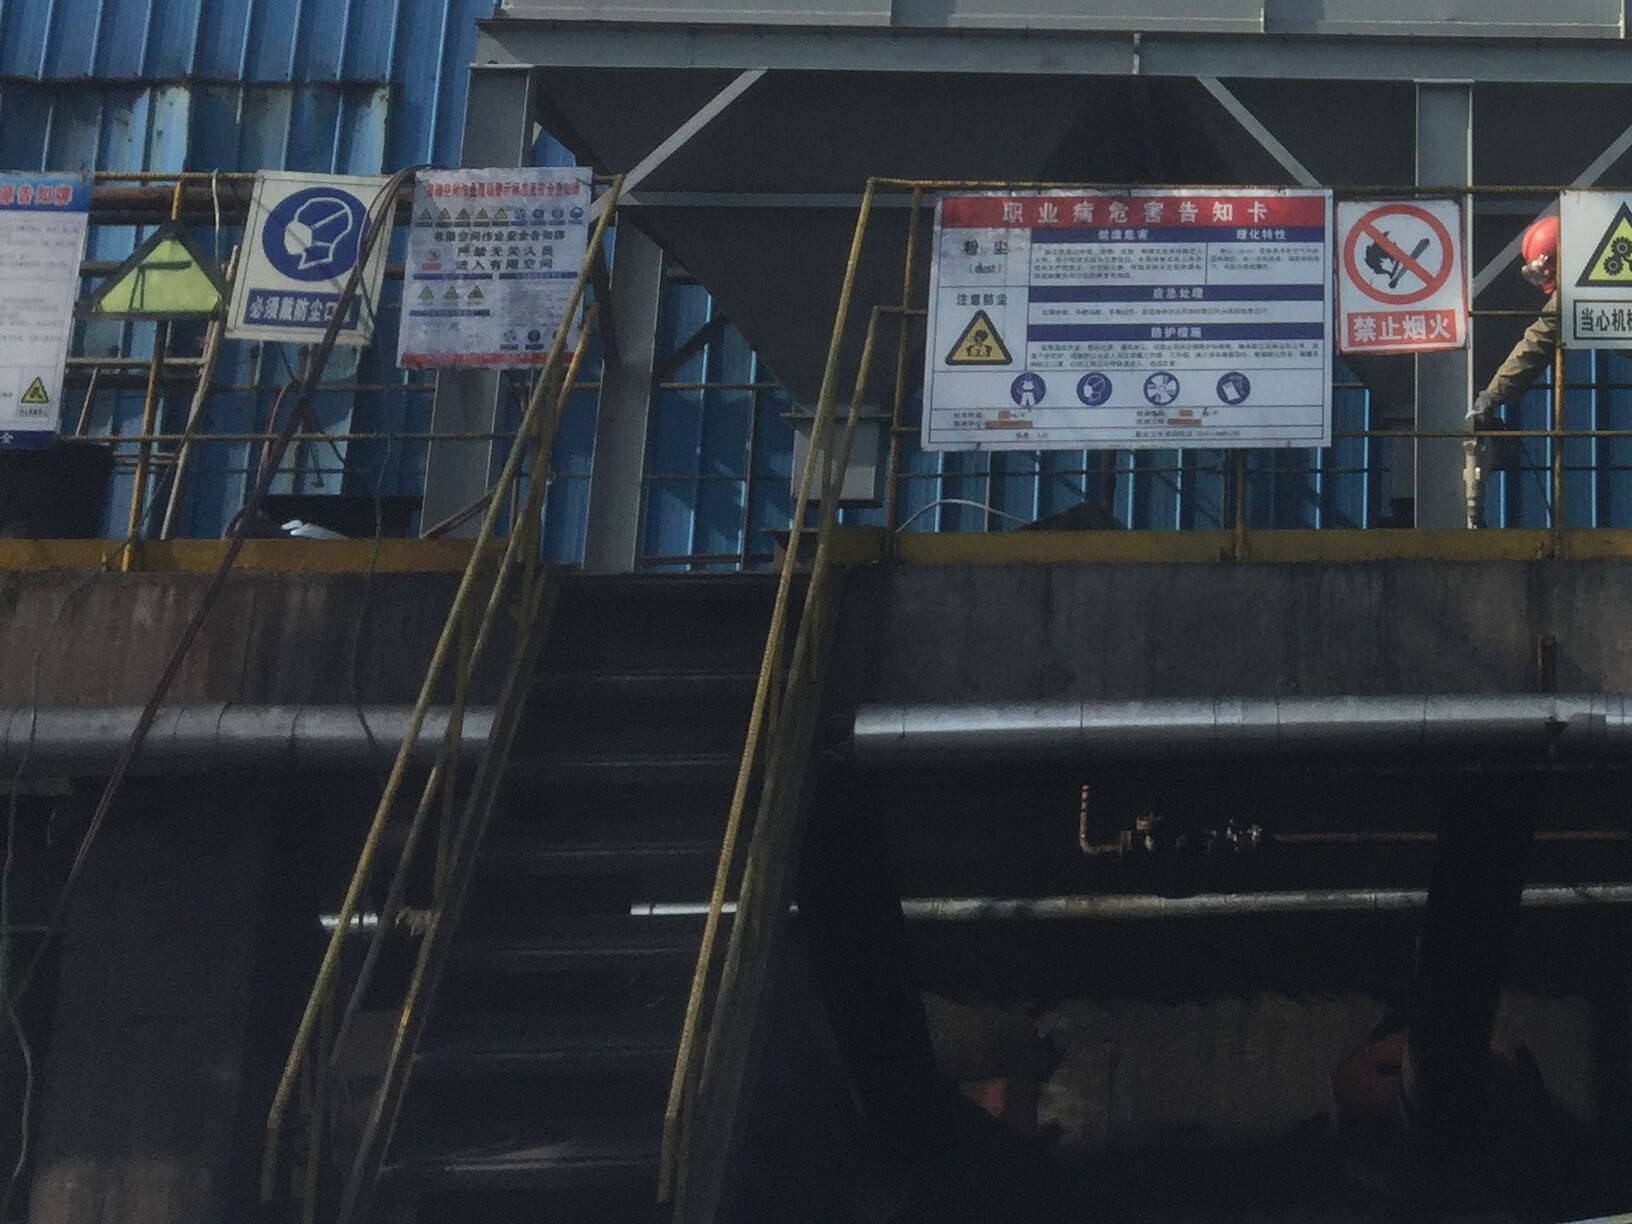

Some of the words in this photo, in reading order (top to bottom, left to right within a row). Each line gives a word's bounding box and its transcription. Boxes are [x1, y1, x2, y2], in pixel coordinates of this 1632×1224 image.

[1002, 201, 1268, 223] 职业病危害告知卡
[1236, 229, 1287, 240] 理化特性
[455, 258, 553, 270] 进入有限空间
[1152, 287, 1203, 299] 应急处理
[250, 295, 351, 324] 必须戴防尘口
[1150, 326, 1202, 338] 防护措施
[1353, 312, 1451, 342] 禁止烟火
